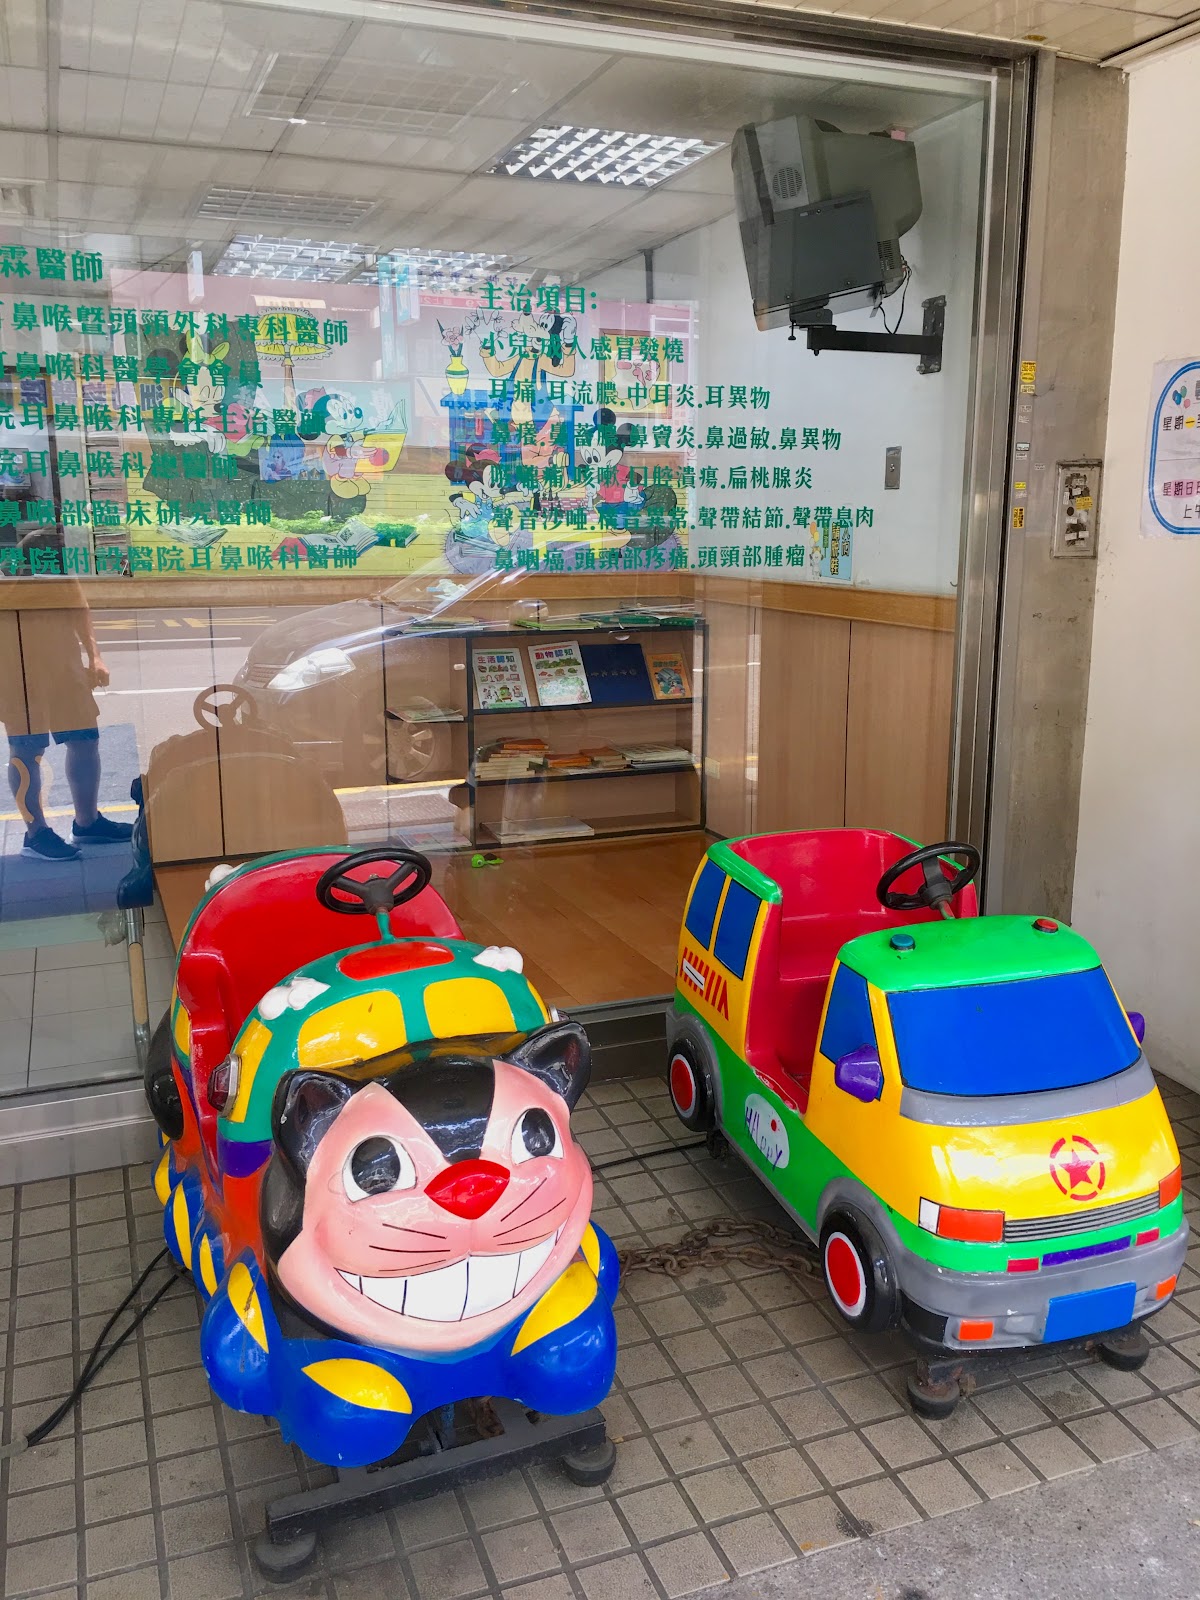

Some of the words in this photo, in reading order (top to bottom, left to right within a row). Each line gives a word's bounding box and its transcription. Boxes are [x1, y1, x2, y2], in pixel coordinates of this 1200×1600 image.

[478, 281, 597, 314] 主治項目:
[0, 301, 349, 347] 鼻喉暨頭頸外科專科醫師
